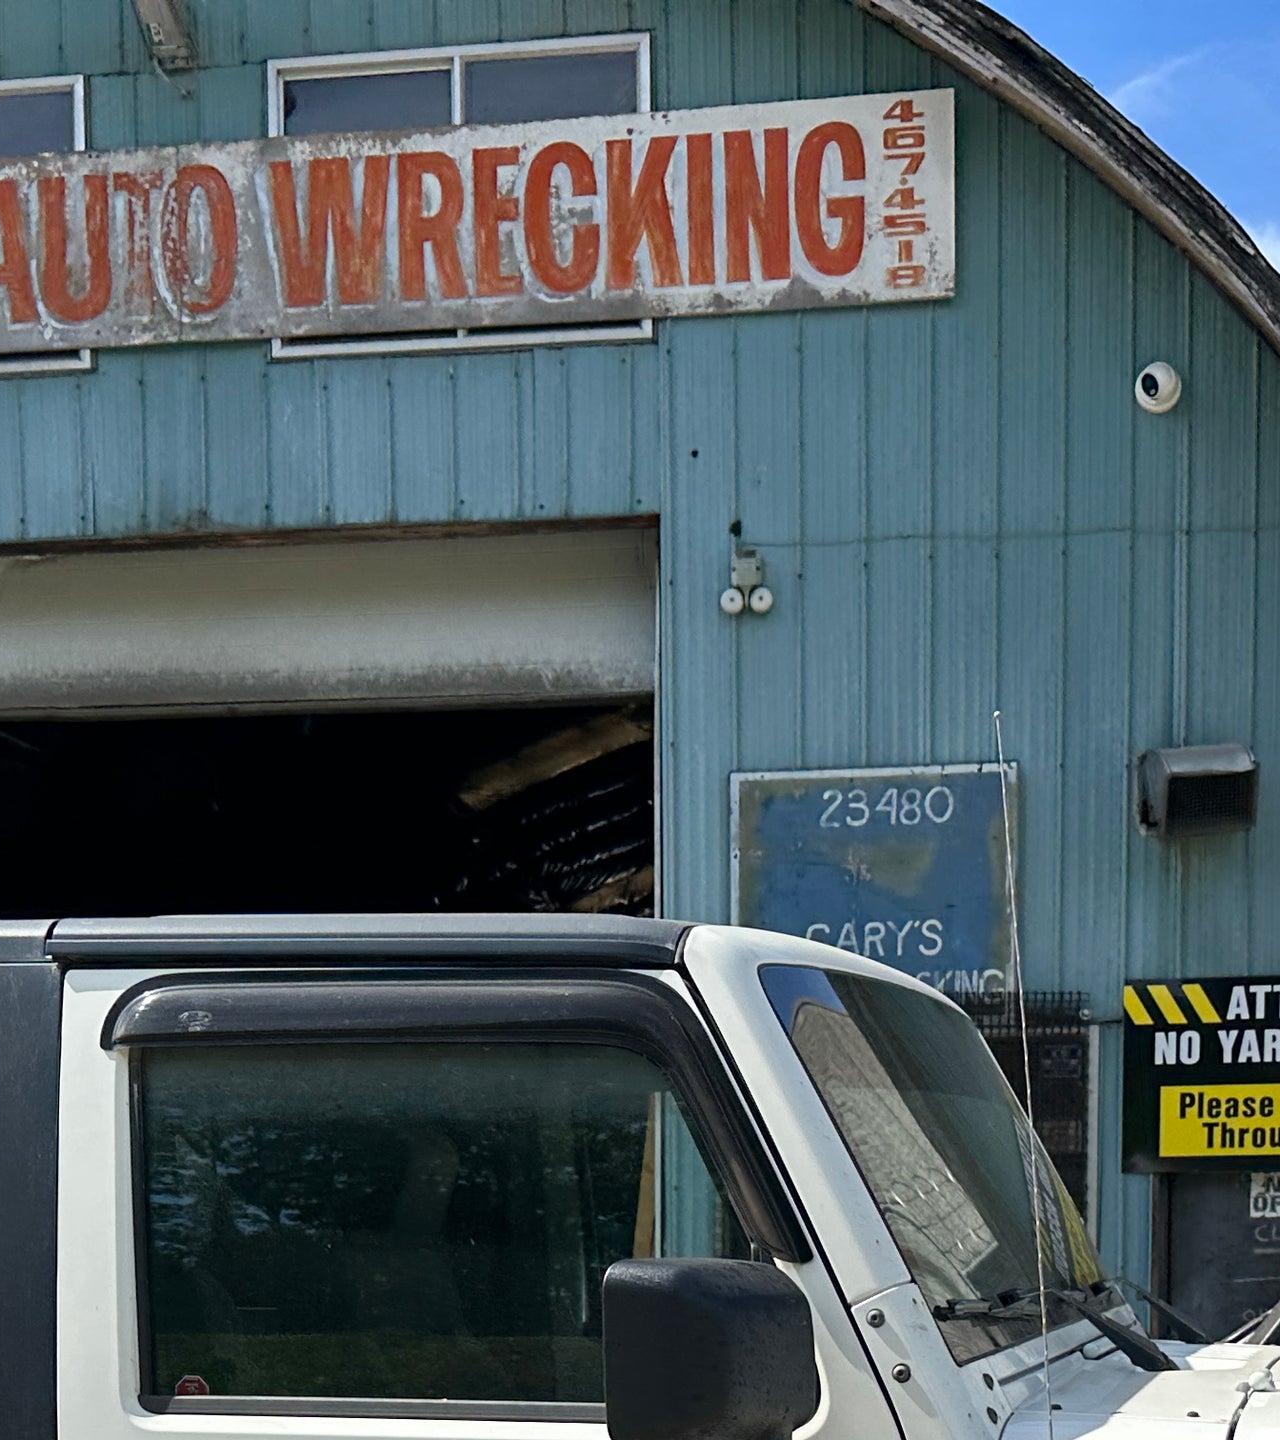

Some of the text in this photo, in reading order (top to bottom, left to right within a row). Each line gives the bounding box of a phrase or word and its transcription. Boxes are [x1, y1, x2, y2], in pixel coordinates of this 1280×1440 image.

[268, 121, 866, 308] WRECKING
[819, 786, 955, 828] 23480
[1154, 1030, 1201, 1066] NO
[1179, 1092, 1274, 1119] Please
